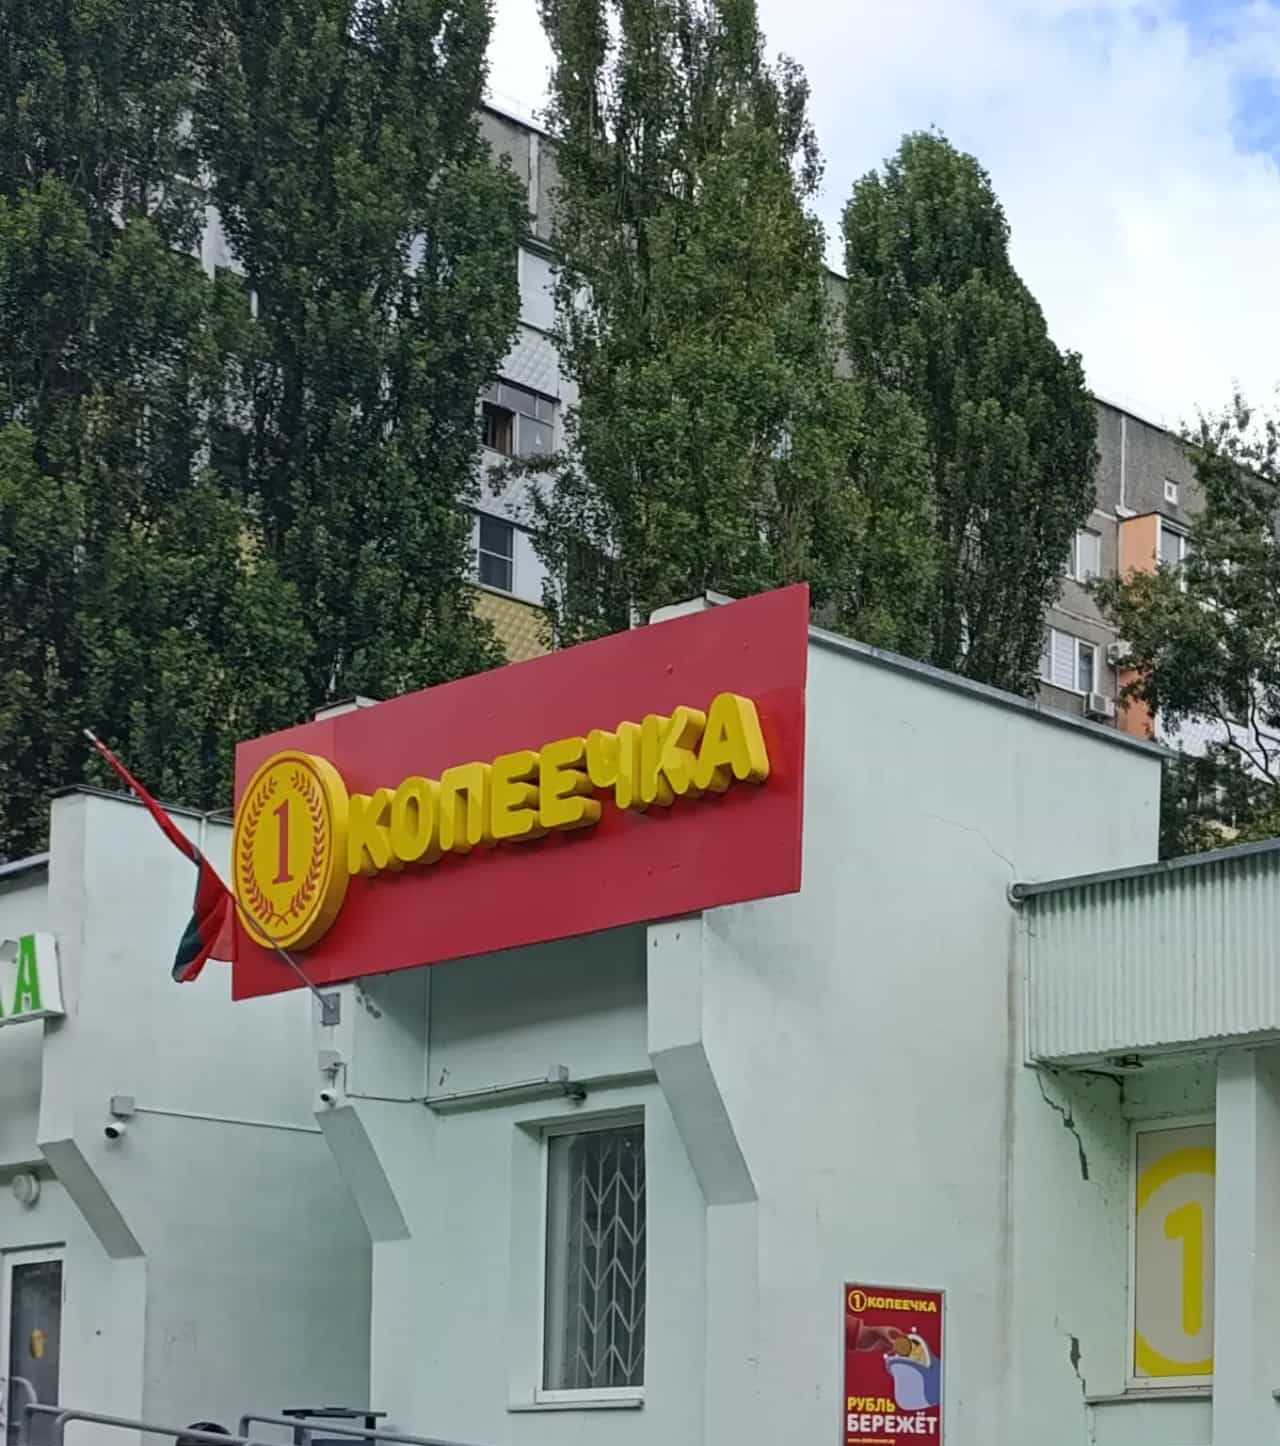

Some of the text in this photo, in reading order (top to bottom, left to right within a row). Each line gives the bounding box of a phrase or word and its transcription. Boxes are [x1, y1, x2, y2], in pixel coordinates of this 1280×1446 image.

[348, 692, 770, 876] КОПЕЕЧКА
[867, 1296, 937, 1313] КОПЕЕЧКА
[847, 1396, 896, 1413] РУБЛЬ
[847, 1412, 937, 1434] БЕРЕЖЁТ
